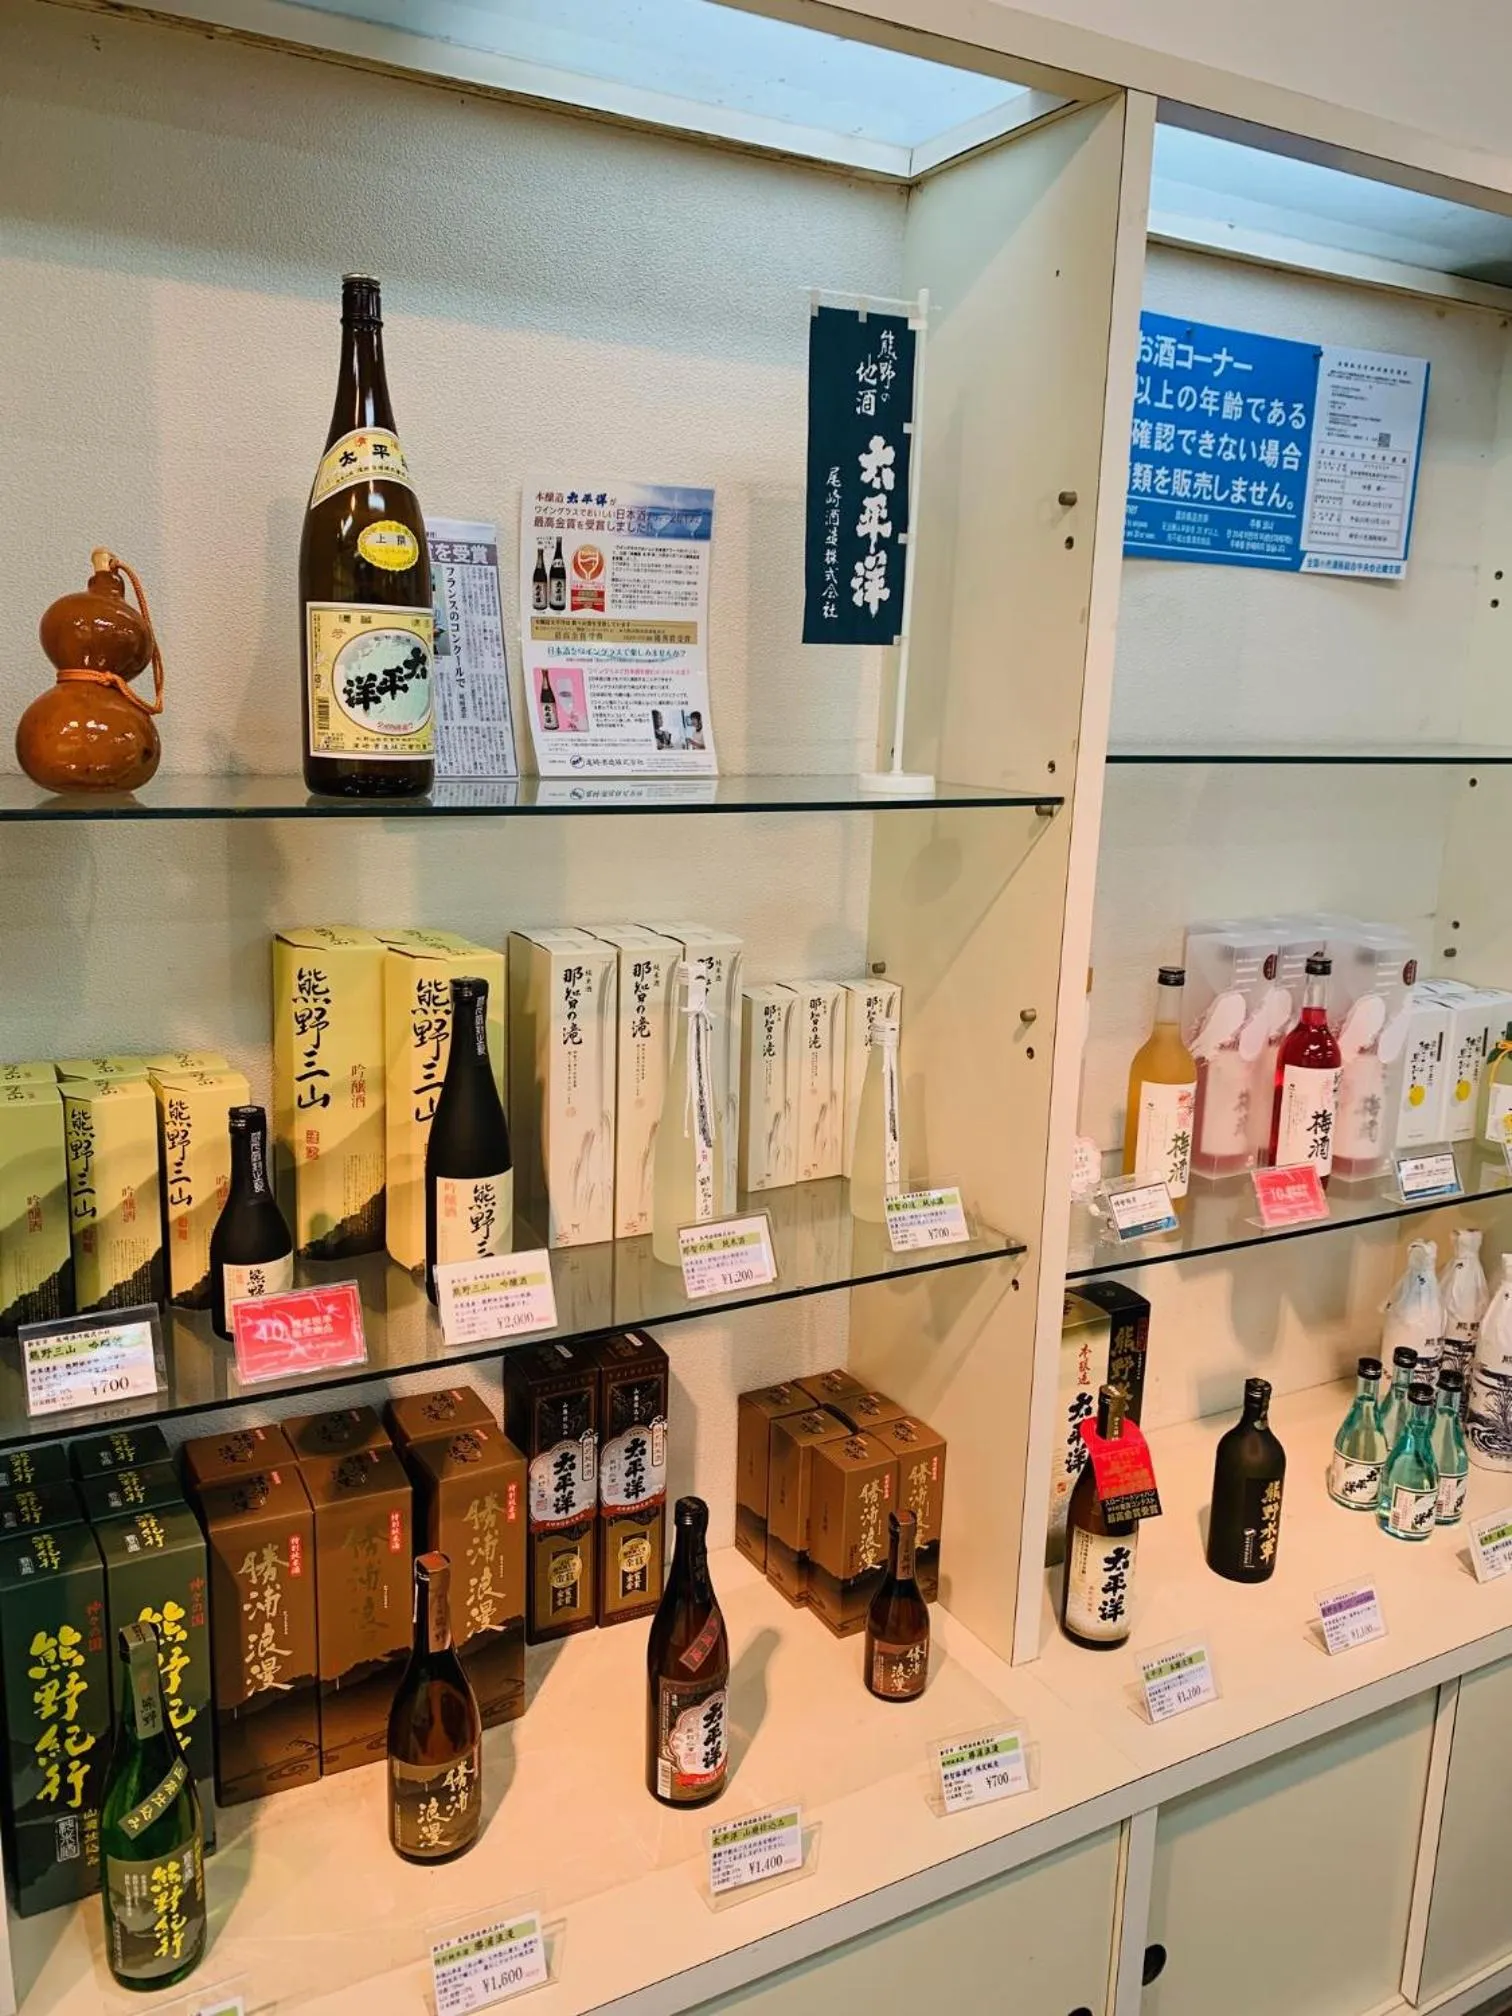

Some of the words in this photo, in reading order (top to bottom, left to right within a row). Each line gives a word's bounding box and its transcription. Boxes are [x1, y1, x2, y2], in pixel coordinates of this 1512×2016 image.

[855, 354, 877, 416] 地酒
[877, 329, 897, 402] 熊野の
[1138, 331, 1253, 377] お酒コーナー
[1135, 374, 1306, 430] 以上の年齢である
[1132, 418, 1302, 472] 確認できない場合
[566, 491, 607, 506] 太平洋
[1128, 462, 1295, 511] 類を販売しません。
[429, 544, 489, 564] を受賞
[820, 466, 842, 619] 尾崎酒造株式会社
[850, 434, 896, 618] 太平洋
[343, 646, 427, 712] 太平洋
[291, 967, 332, 1110] 熊野三山
[350, 1063, 367, 1109] 吟醸酒
[68, 1109, 97, 1219] 熊野三山
[164, 1098, 193, 1207] 熊野三山
[1306, 1109, 1333, 1161] 梅酒
[553, 1452, 577, 1515] 太平洋
[624, 1437, 647, 1500] 太平洋
[857, 1478, 884, 1573] 勝浦浪漫
[463, 1494, 508, 1638] 勝浦浪漫
[1097, 1546, 1131, 1622] 太平洋
[237, 1542, 297, 1697] 勝浦浪漫
[28, 1624, 96, 1809] 熊野紀行
[702, 1701, 724, 1770] 太平洋
[150, 1860, 188, 1960] 熊野紀行
